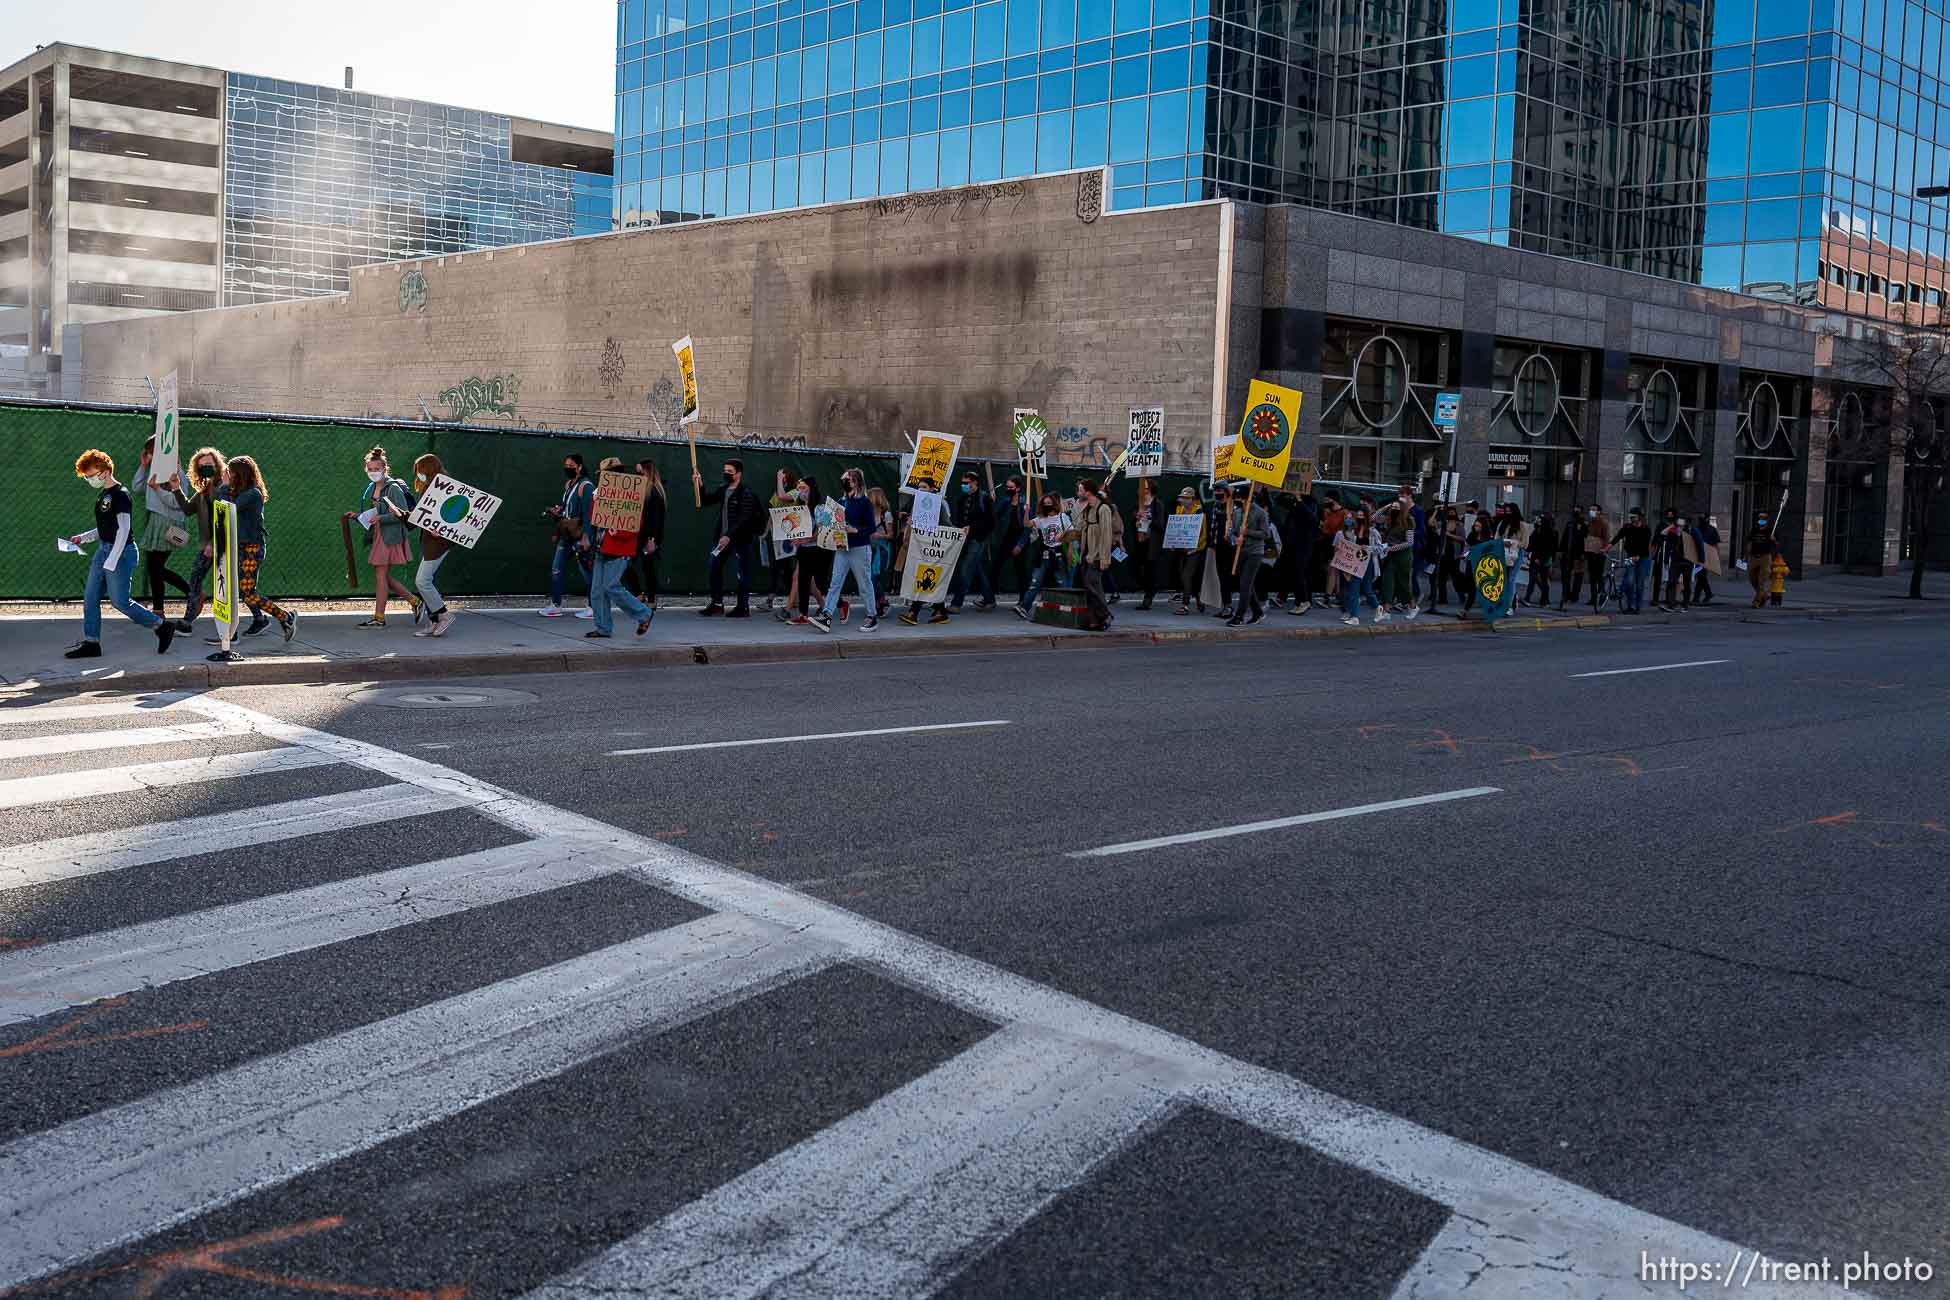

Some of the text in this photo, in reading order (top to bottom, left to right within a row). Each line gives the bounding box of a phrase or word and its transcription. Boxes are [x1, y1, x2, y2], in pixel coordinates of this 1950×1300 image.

[1265, 393, 1281, 405] SUN
[1131, 411, 1161, 424] PROTECT
[1127, 454, 1160, 467] HEALTH
[1240, 456, 1276, 473] WE BUILD
[602, 472, 642, 491] STOP
[434, 477, 496, 513] We are all
[599, 486, 641, 502] DENYING
[423, 494, 488, 531] in this
[598, 498, 641, 512] THE EARTH
[417, 507, 474, 546] Together
[912, 526, 926, 537] NO
[927, 527, 964, 542] FUTURE
[931, 538, 942, 548] IN
